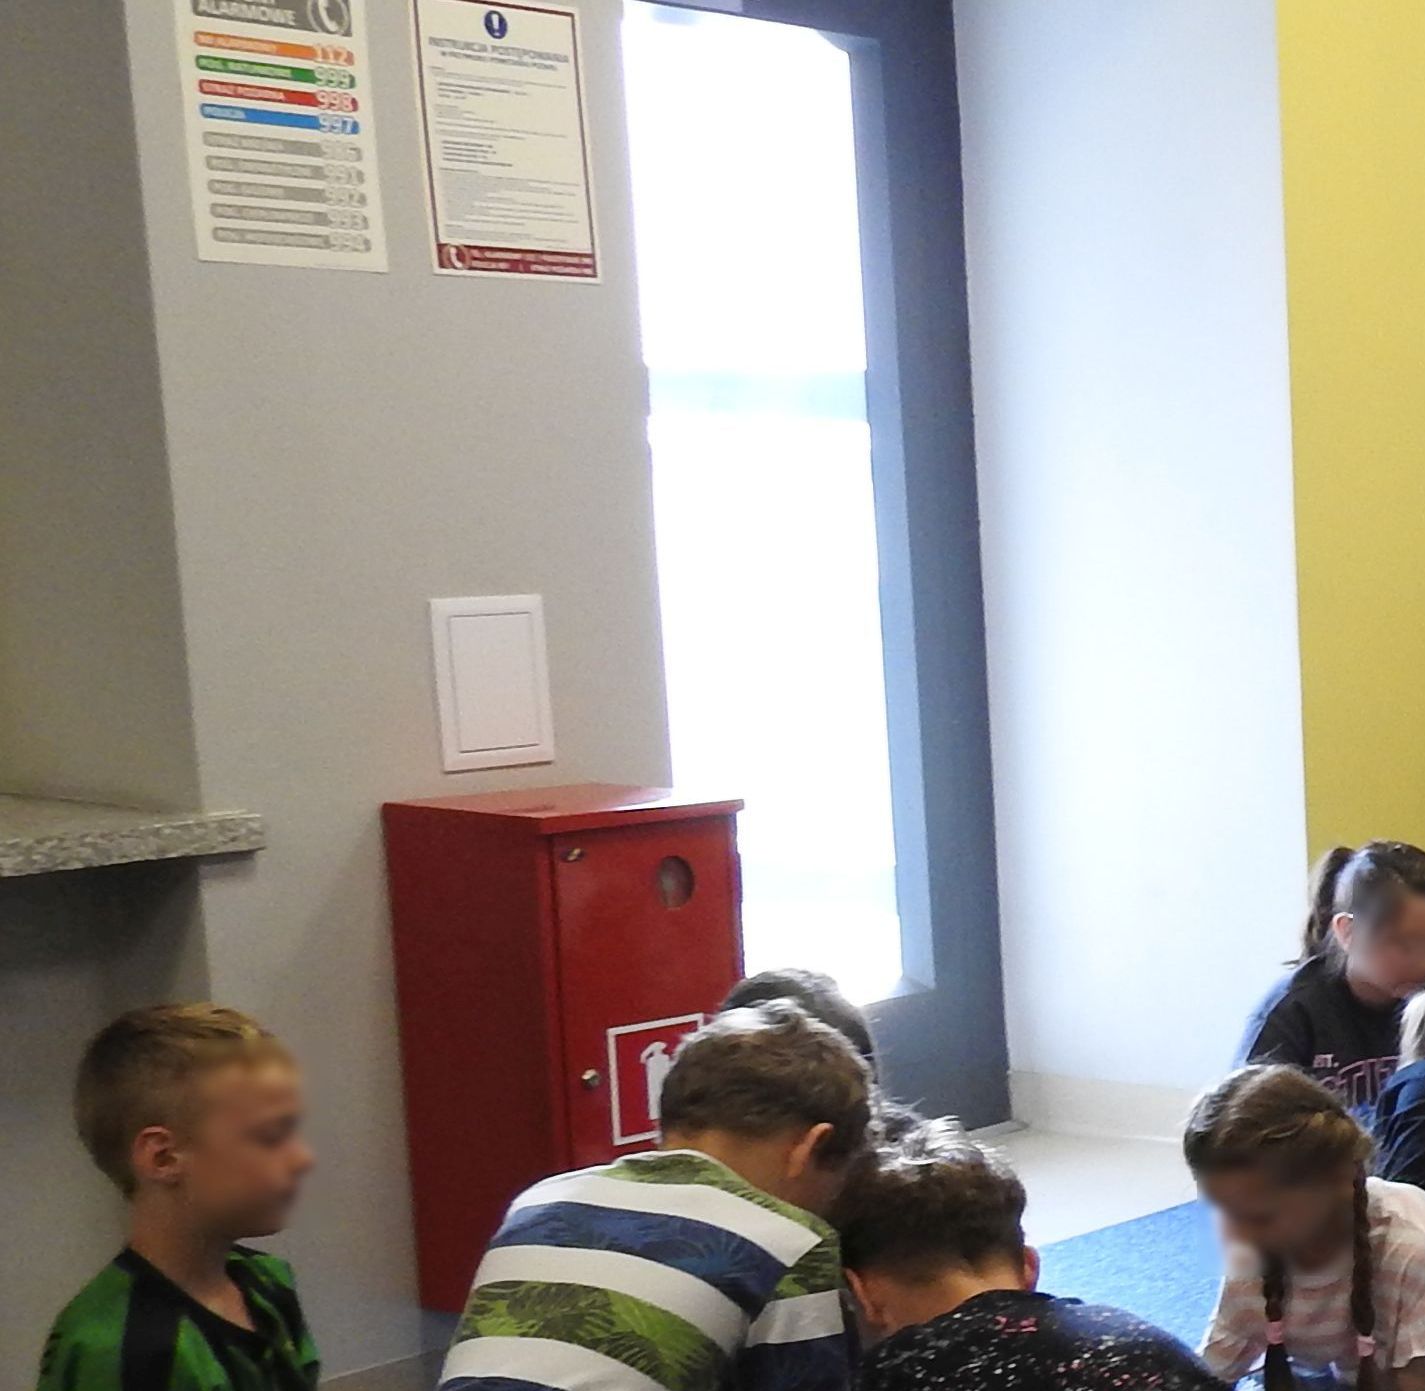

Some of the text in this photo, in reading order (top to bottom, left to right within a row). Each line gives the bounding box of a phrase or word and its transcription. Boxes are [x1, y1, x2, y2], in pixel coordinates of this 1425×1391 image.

[312, 44, 350, 66] 112
[314, 66, 351, 89] 999
[316, 90, 353, 112] 998
[318, 113, 355, 134] 997
